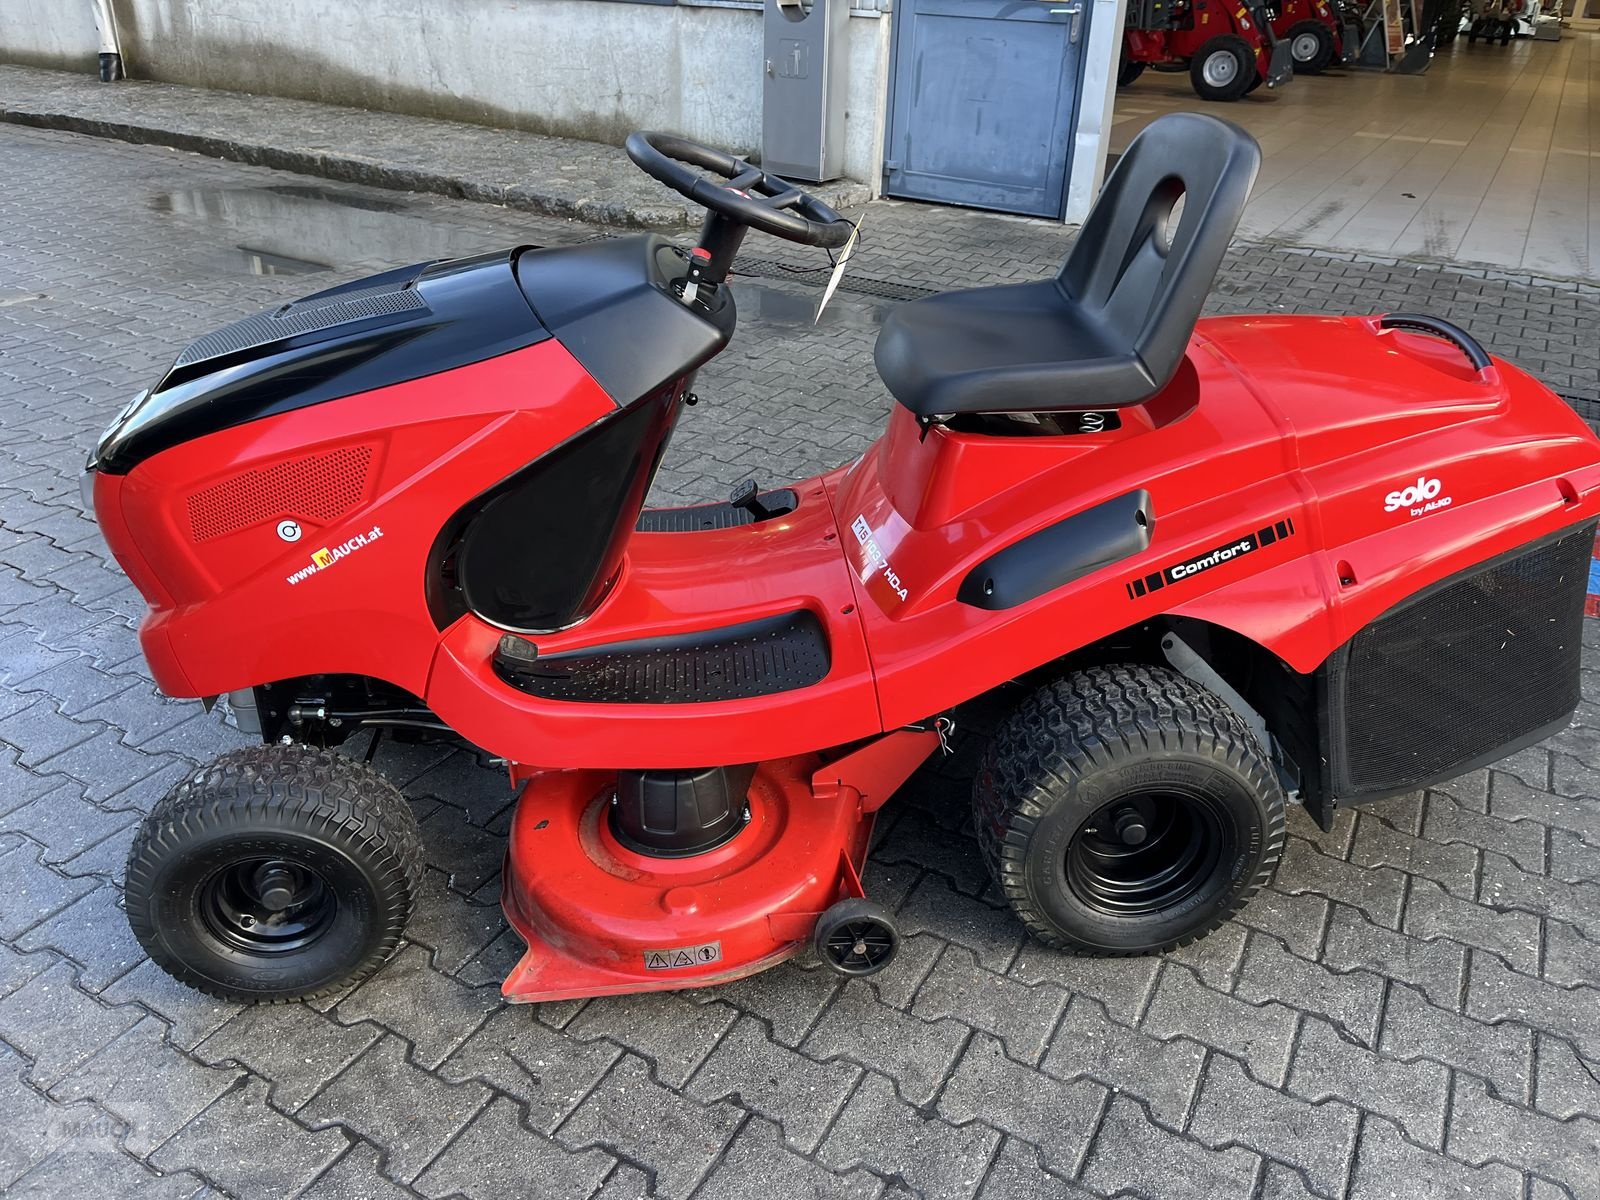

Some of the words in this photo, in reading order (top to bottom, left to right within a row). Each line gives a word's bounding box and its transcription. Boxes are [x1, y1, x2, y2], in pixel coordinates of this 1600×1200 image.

[1384, 476, 1442, 512] solo
[1410, 506, 1425, 517] by
[285, 525, 384, 585] www.MAUCH.at
[866, 539, 889, 569] 103.7
[883, 567, 909, 602] HD-A
[1170, 540, 1252, 581] Comfort
